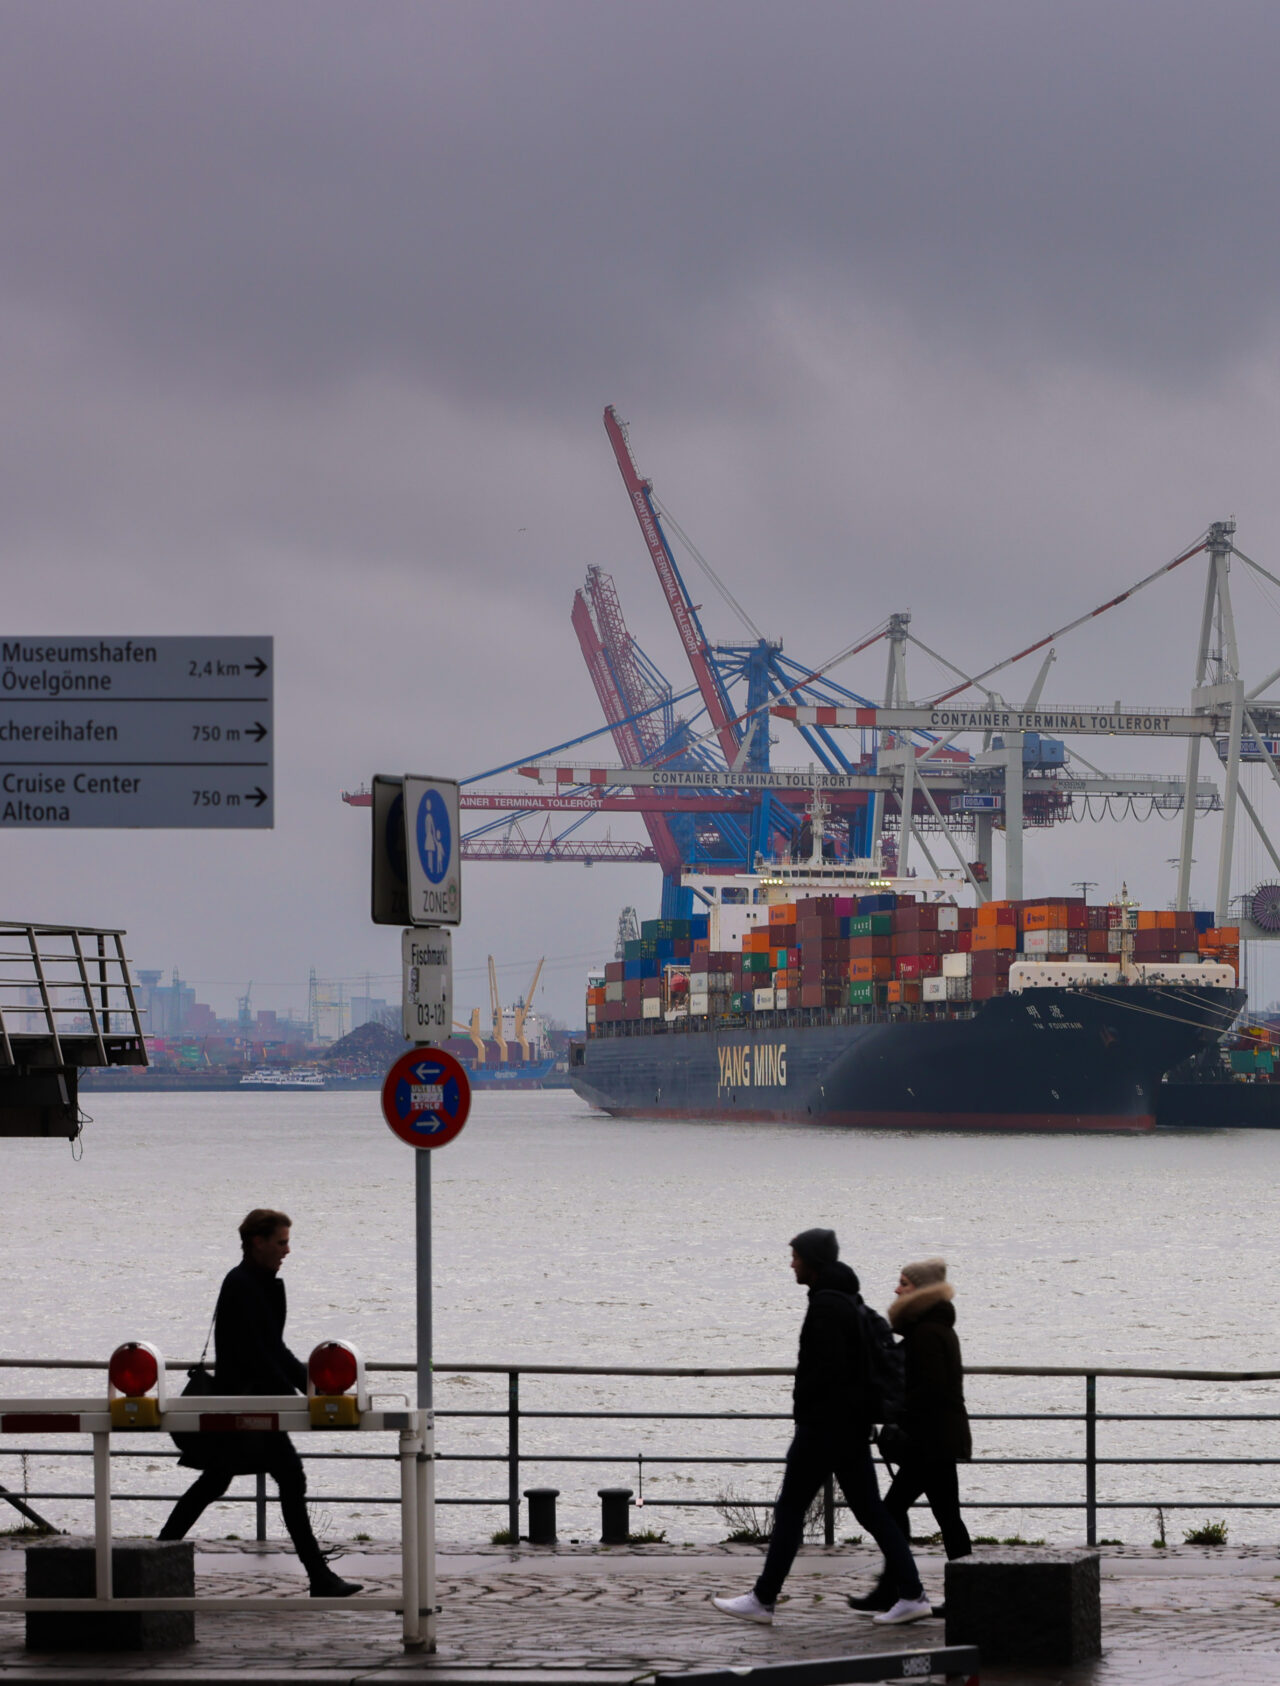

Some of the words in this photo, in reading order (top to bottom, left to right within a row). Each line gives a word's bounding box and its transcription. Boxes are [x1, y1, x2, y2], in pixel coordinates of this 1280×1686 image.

[2, 641, 157, 662] Museumshafen
[188, 661, 212, 678] 2,4
[217, 661, 240, 676] km
[2, 667, 112, 695] Övelgönne
[0, 720, 118, 741] chereihafen
[931, 712, 1010, 727] CONTAINER
[1017, 714, 1086, 728] TERMINAL
[1091, 716, 1170, 730] TOLLERORT
[192, 726, 221, 741] 750
[227, 729, 240, 741] m
[2, 773, 66, 793] Cruise
[73, 773, 141, 793] Center
[653, 772, 719, 784] CONTAINER
[724, 774, 782, 786] TERMINAL
[786, 775, 853, 787] TOLLRORT
[192, 791, 221, 806] 750
[227, 794, 240, 806] m
[495, 798, 544, 807] TERMINAL
[548, 799, 603, 808] TOLLERORT
[2, 801, 70, 821] Altona
[423, 890, 448, 914] ZONE
[411, 944, 448, 965] Fischmarkt
[717, 1045, 750, 1087] YANG
[754, 1044, 787, 1087] MING
